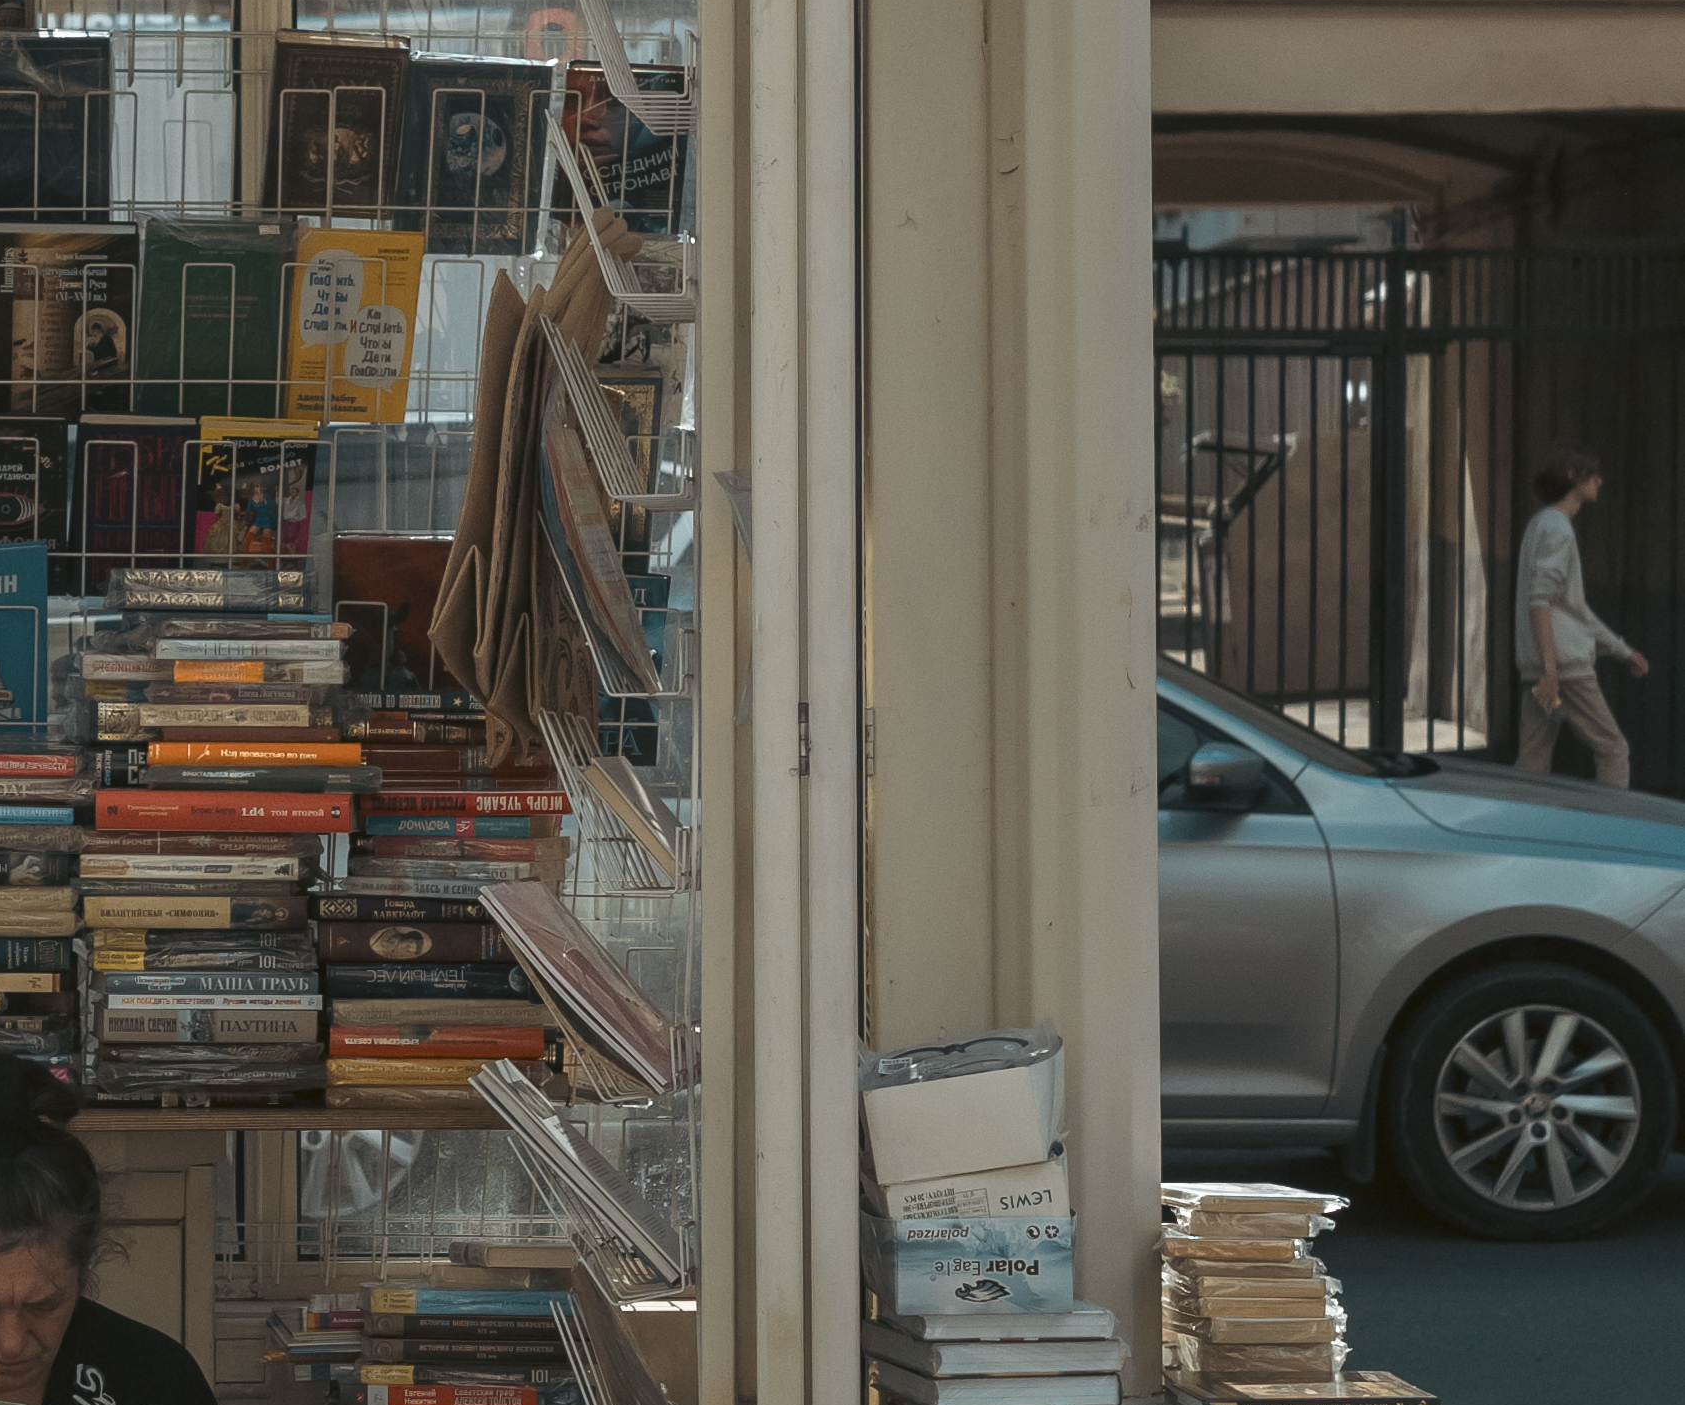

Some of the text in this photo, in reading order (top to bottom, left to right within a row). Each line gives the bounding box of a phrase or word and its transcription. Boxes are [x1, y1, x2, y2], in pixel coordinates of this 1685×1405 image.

[476, 796, 563, 813] ИГОРЬ ЧУБАЙС
[452, 884, 481, 895] СЕЙЧА
[99, 908, 163, 919] ВИЗАНТИЙСКАЯ
[199, 977, 255, 992] МАША
[258, 977, 310, 993] ТРАУБ
[399, 969, 468, 985] ТЕМНЫЙ
[219, 1019, 299, 1034] ПАУТИНА
[999, 1188, 1053, 1211] LEWIS
[907, 1227, 969, 1241] polarized
[934, 1258, 1039, 1277] Polar Eagle
